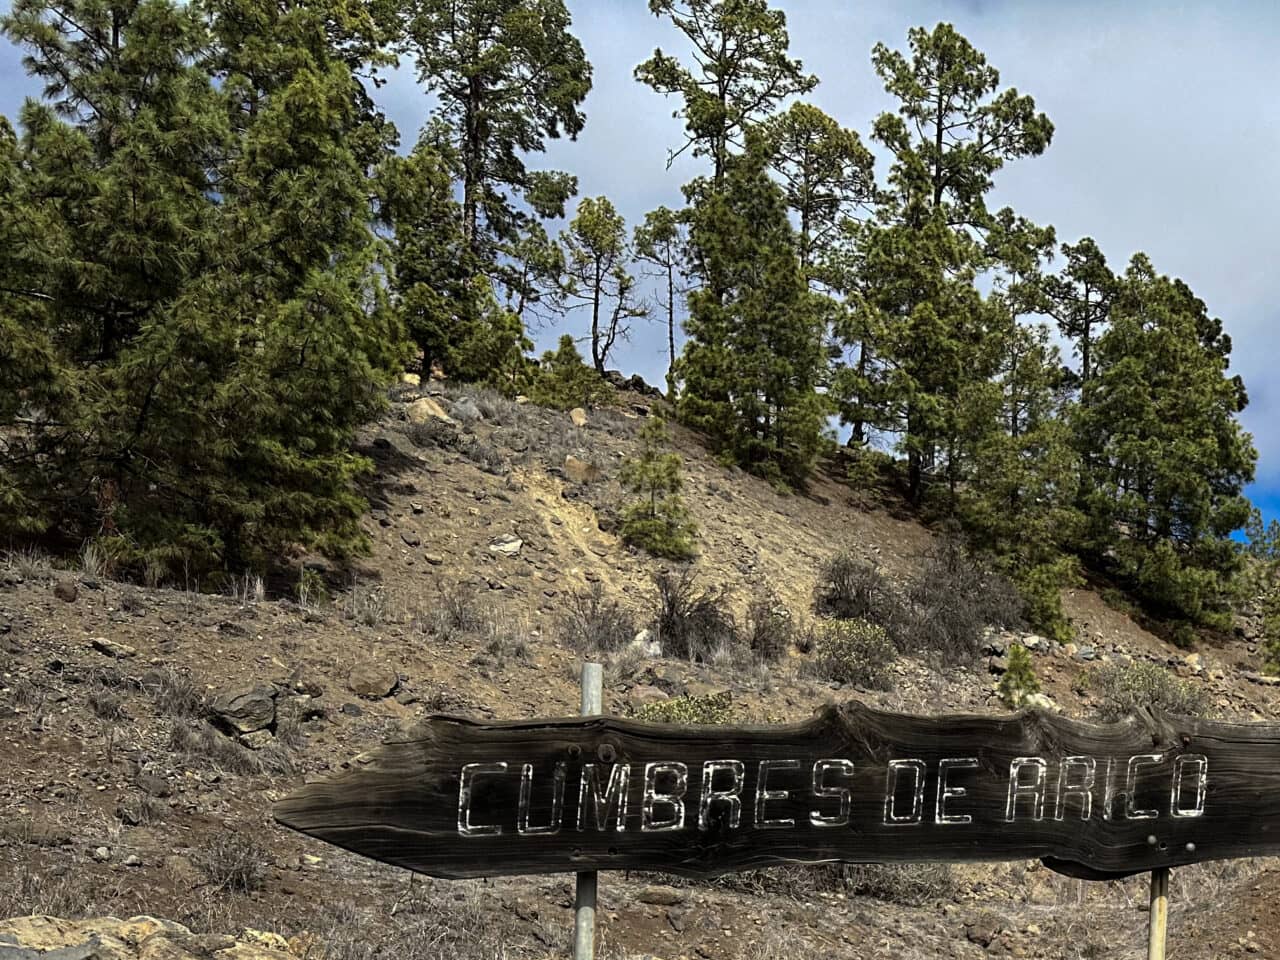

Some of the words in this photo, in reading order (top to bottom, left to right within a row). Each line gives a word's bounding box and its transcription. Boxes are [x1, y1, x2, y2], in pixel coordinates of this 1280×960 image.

[457, 760, 854, 836] CUMBRES
[883, 758, 978, 825] DE
[1005, 754, 1209, 823] ARICO
